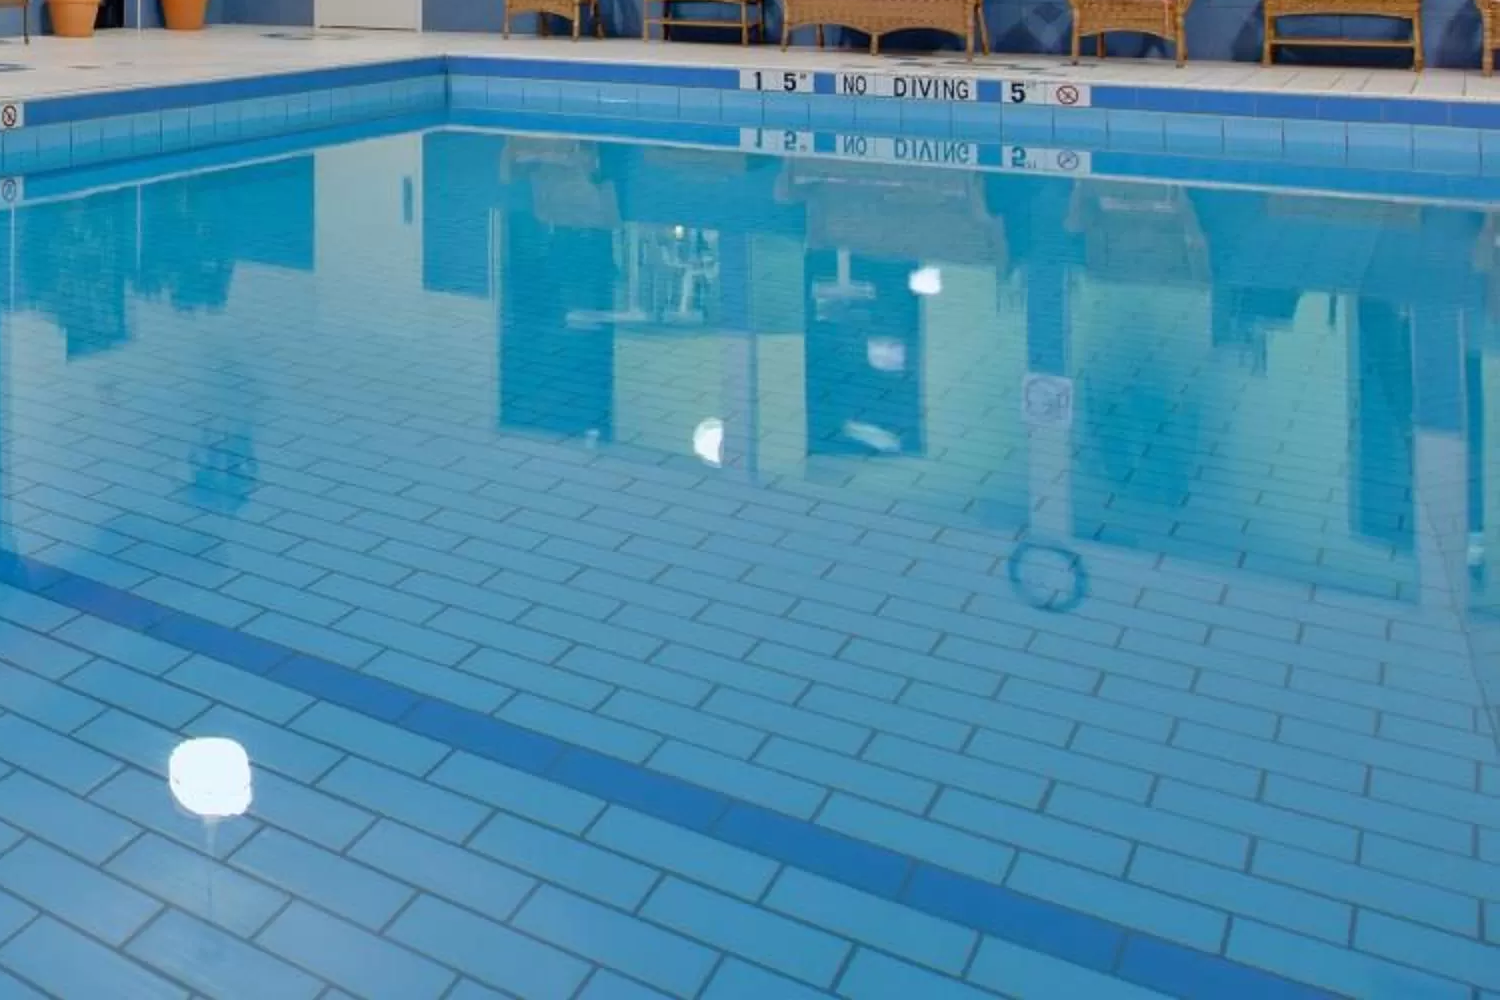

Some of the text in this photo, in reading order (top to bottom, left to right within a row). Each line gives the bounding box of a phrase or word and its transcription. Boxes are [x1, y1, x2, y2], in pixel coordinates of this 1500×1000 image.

[753, 71, 797, 92] 1 5
[843, 75, 969, 100] NO DIVING
[1011, 83, 1026, 103] 5
